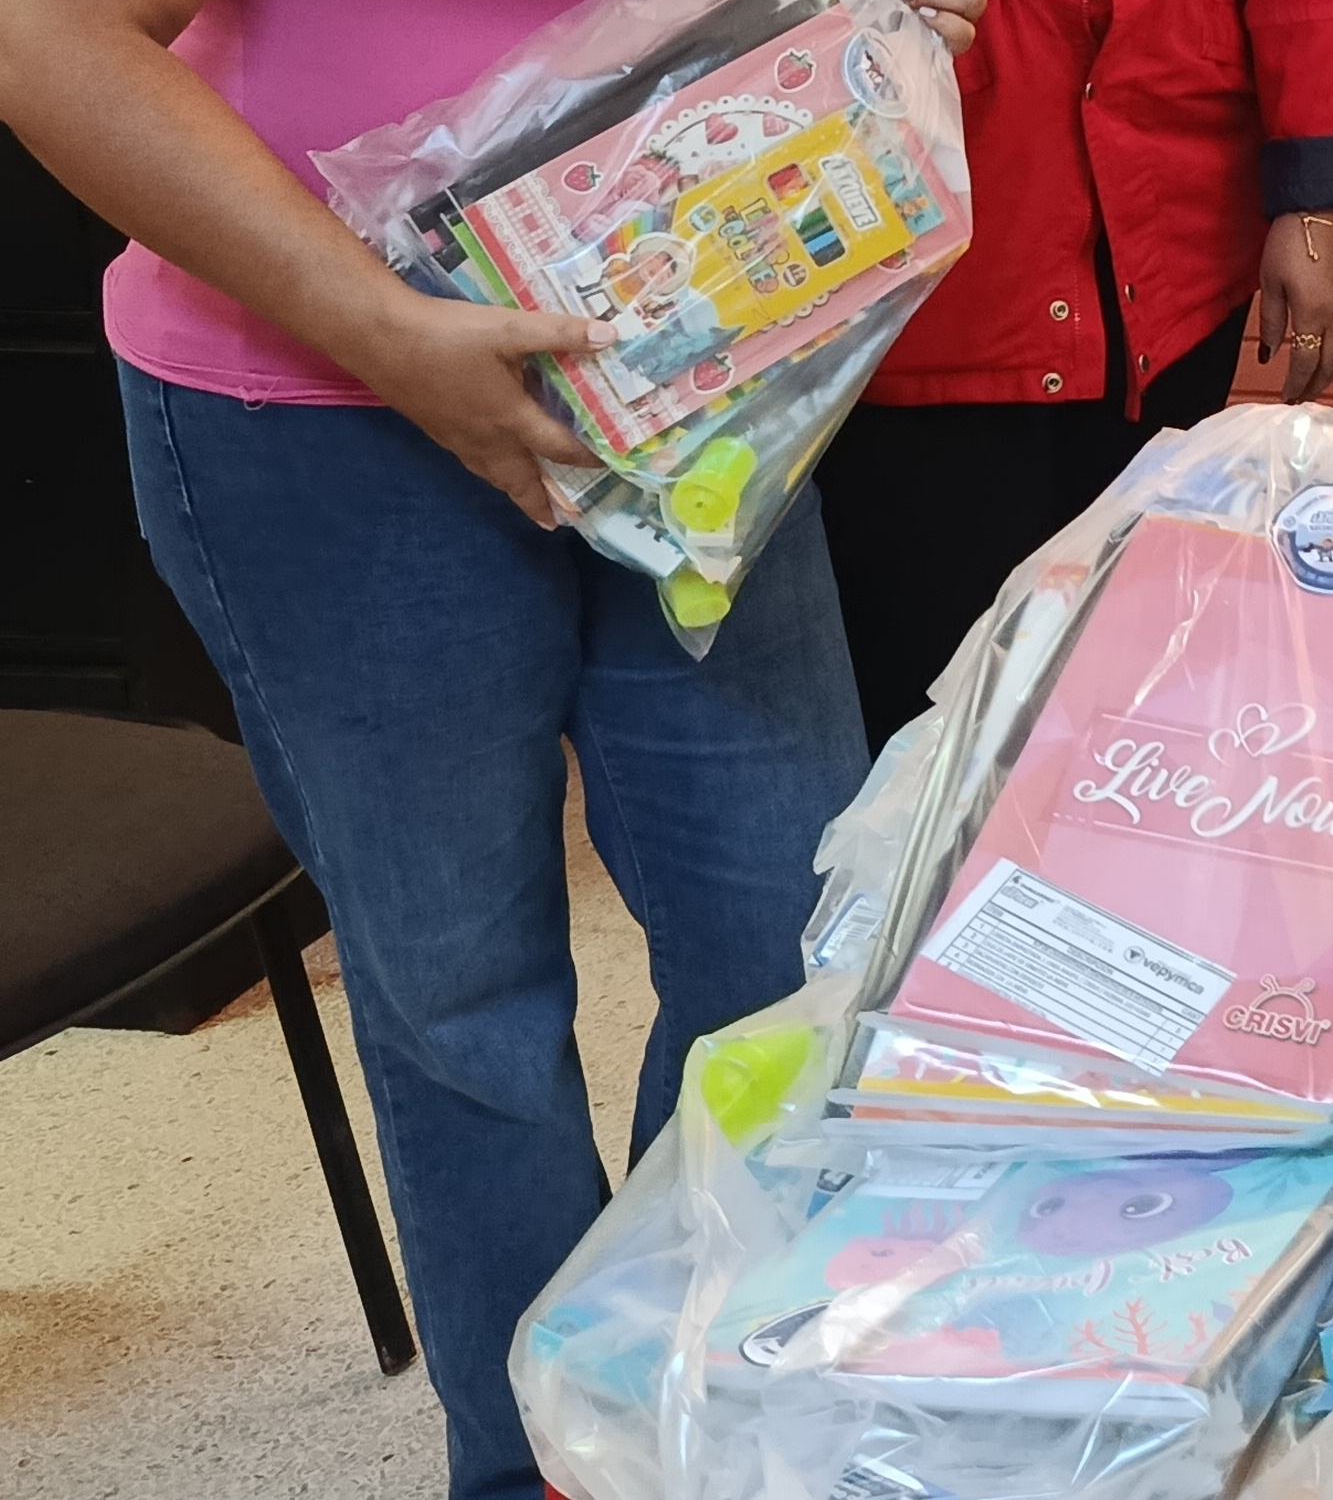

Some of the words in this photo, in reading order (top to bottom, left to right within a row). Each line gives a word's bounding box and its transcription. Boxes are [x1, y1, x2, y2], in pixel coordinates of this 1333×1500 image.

[1073, 739, 1212, 825] Live
[1143, 959, 1205, 995] vepymca
[1223, 1006, 1321, 1045] CRISVI
